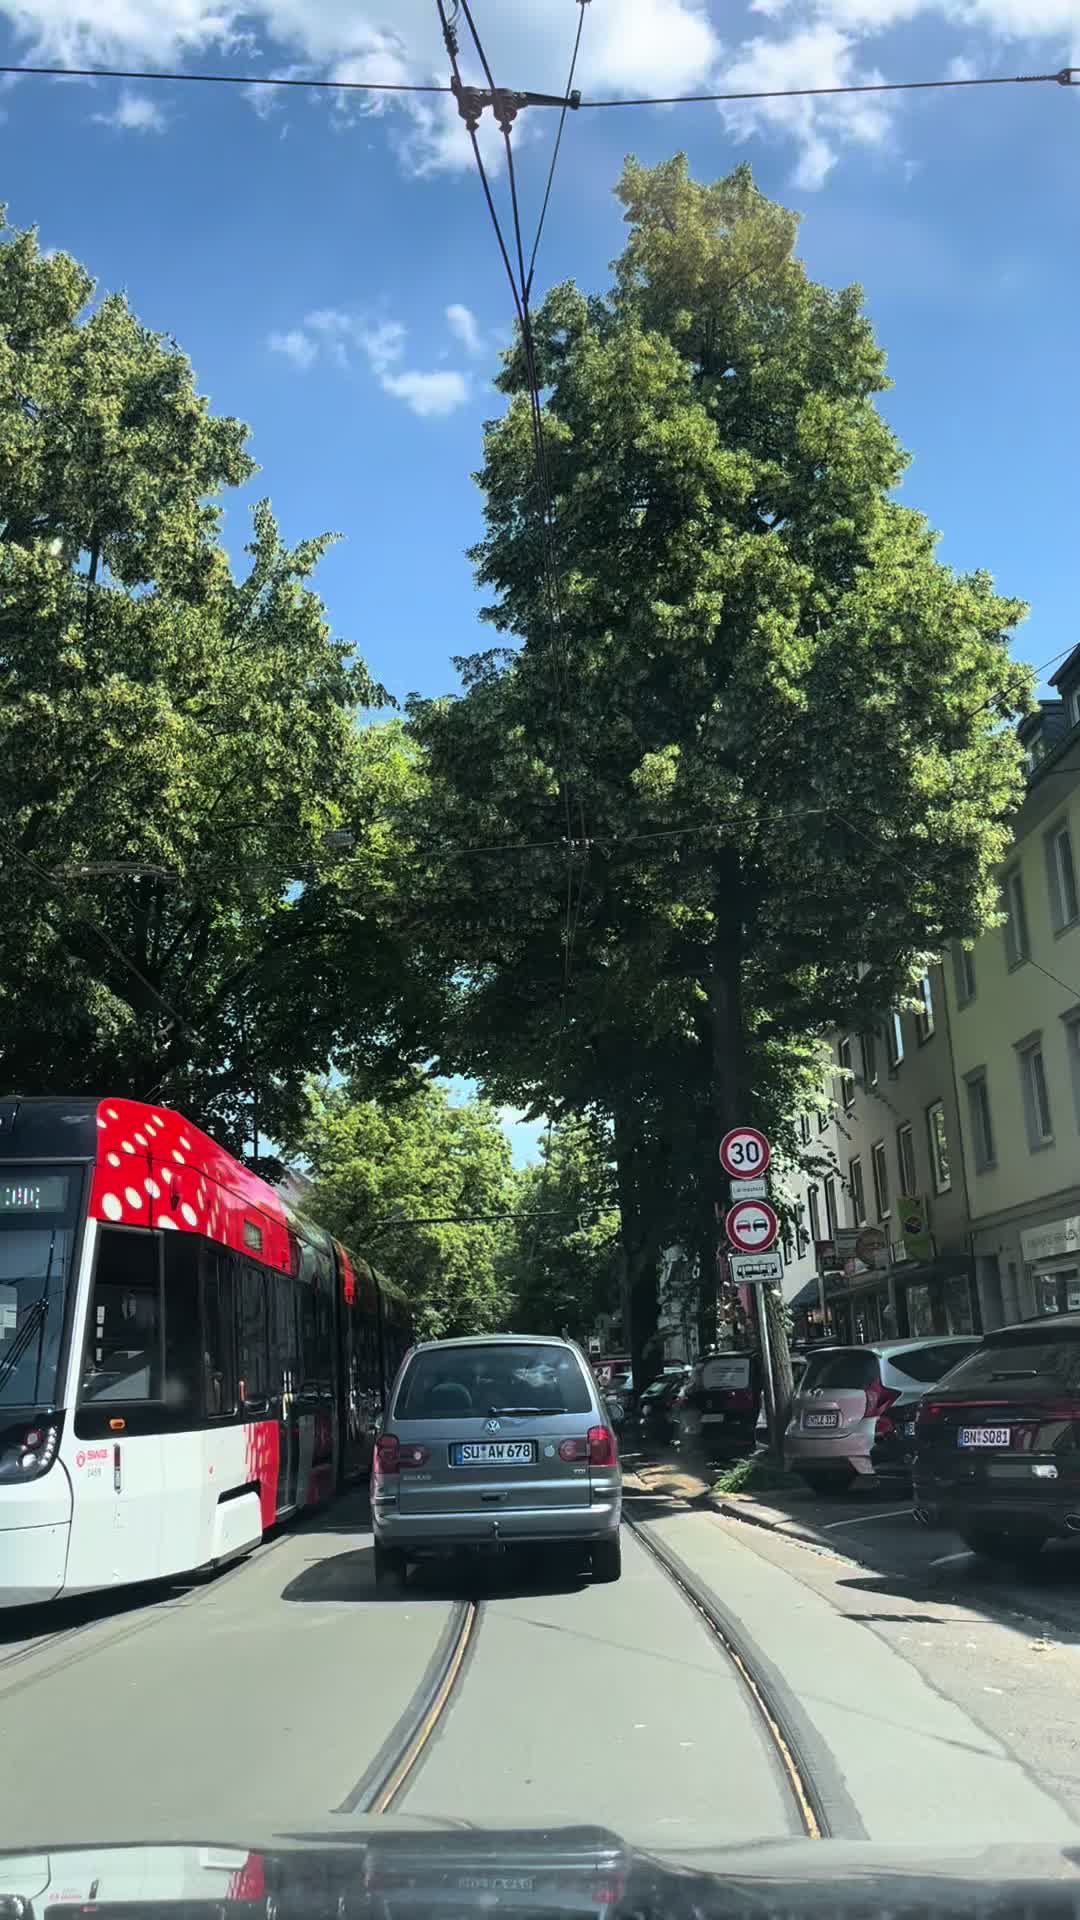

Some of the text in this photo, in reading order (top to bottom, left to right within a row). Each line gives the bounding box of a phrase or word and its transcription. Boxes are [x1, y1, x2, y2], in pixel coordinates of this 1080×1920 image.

[731, 1141, 759, 1164] 30
[963, 1430, 977, 1443] BN
[463, 1446, 480, 1459] SU
